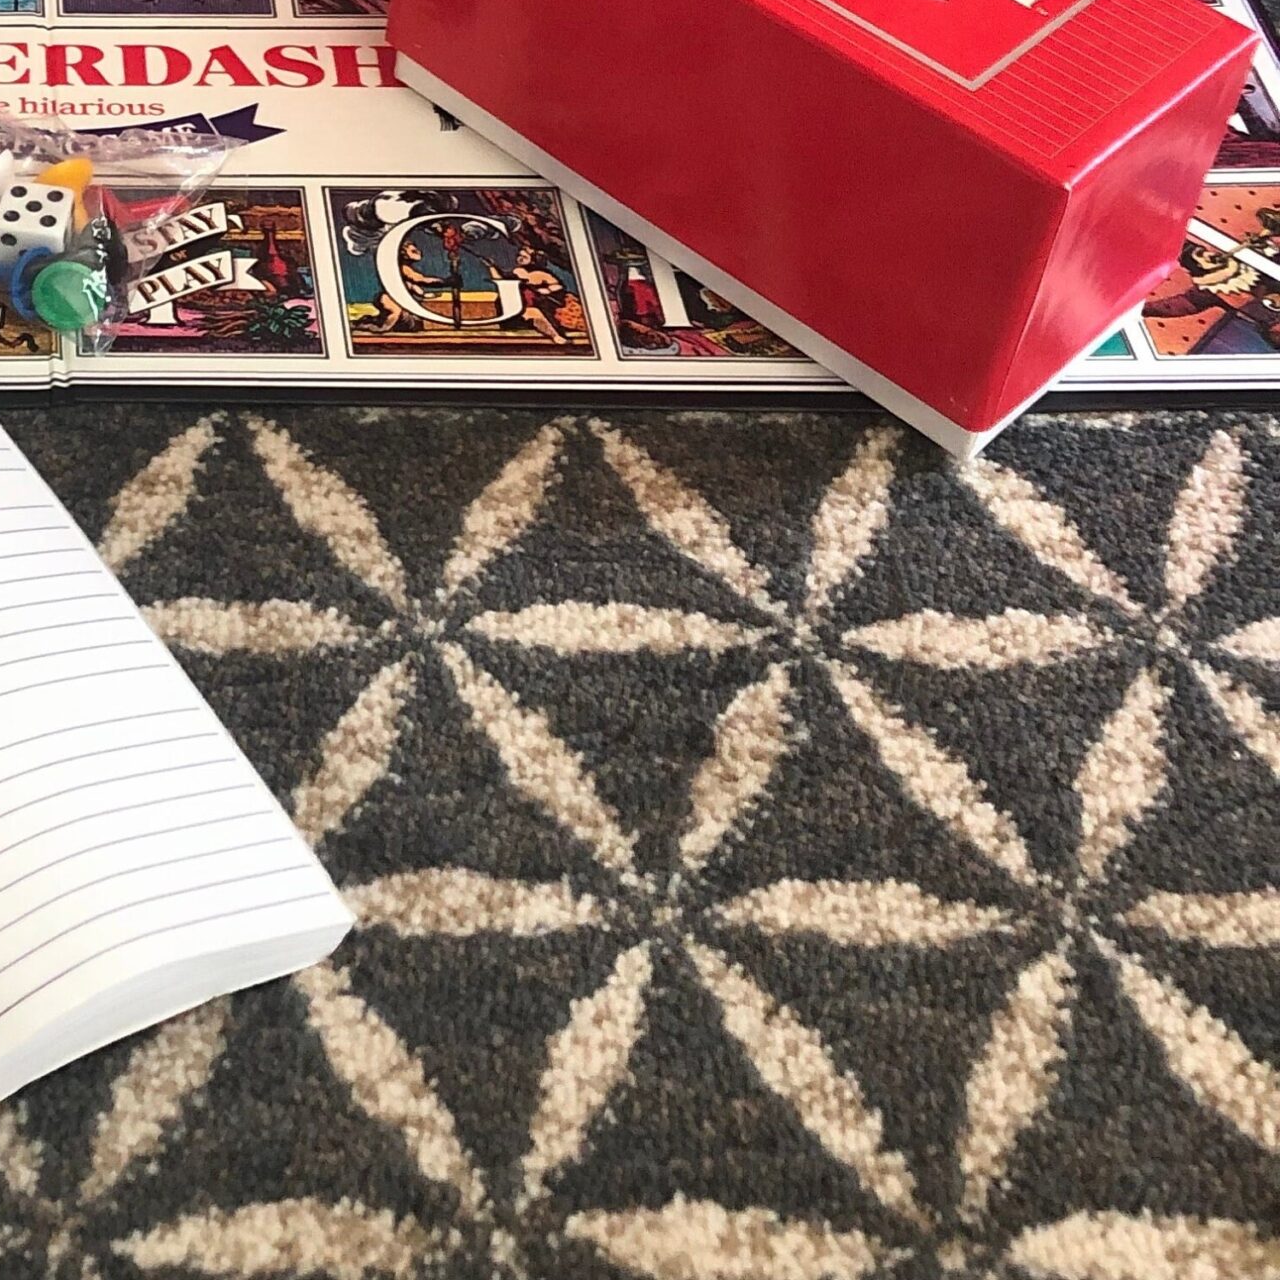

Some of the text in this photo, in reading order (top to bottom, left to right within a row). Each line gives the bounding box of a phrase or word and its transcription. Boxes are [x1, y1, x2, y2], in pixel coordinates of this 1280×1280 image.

[19, 97, 165, 116] hilarious
[132, 208, 220, 254] STAY
[137, 258, 226, 304] PLAY
